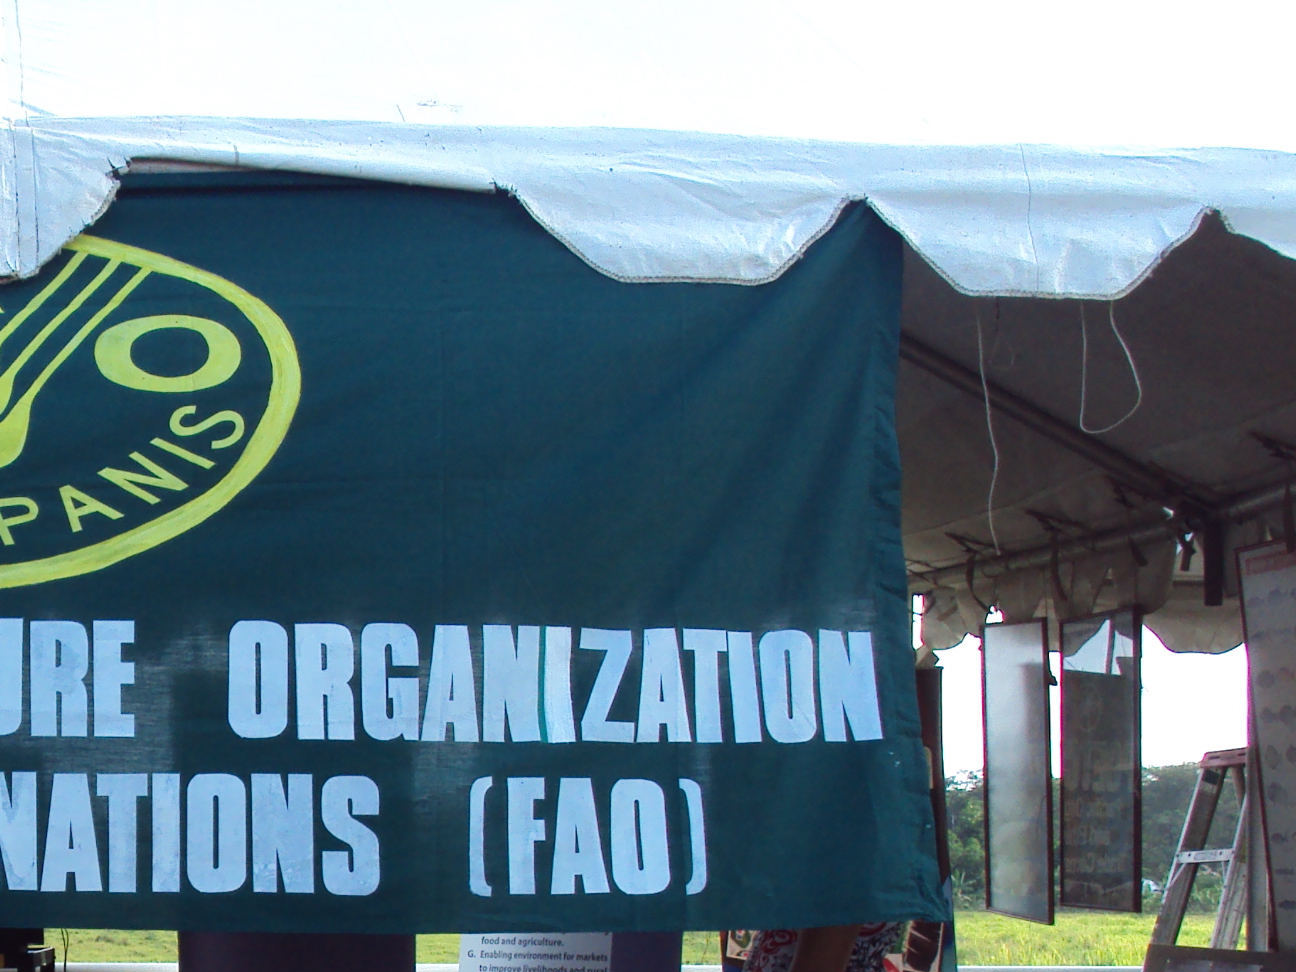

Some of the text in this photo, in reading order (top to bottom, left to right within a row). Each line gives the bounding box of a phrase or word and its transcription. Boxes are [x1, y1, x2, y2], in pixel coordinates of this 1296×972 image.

[228, 620, 884, 744] ORGANIZATION
[469, 776, 707, 898] (FAO)
[468, 950, 607, 962] G. Enabling environment for markets
[482, 936, 564, 948] food and agriculture.
